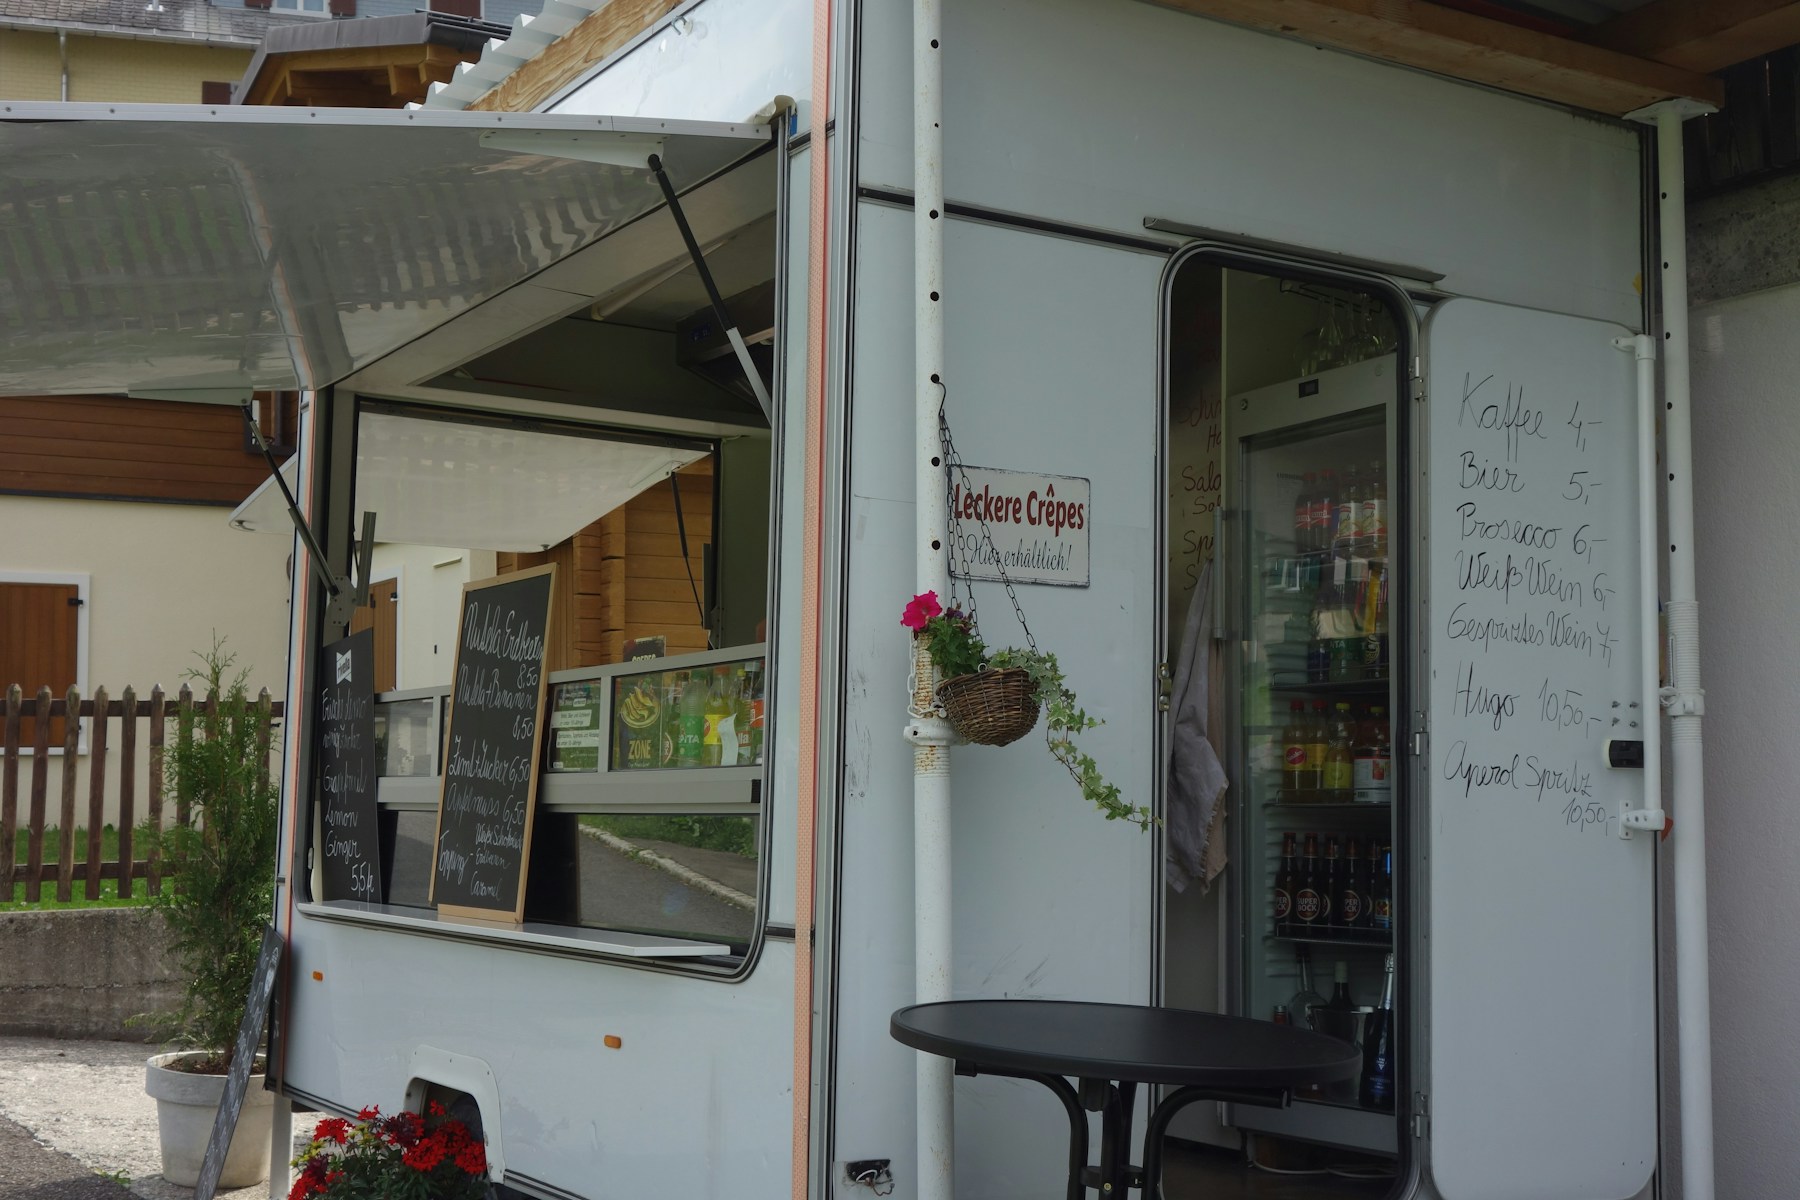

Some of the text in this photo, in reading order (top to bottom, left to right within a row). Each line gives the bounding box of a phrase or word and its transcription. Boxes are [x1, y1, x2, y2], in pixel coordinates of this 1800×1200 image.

[1458, 372, 1547, 462] Kaffee
[1459, 451, 1525, 492] Bier
[954, 483, 1084, 537] Leckere Crêpes
[1456, 502, 1563, 549] Prosecco
[1004, 538, 1072, 571] erhältlich!
[1546, 610, 1592, 657] Wein
[1453, 660, 1521, 731] Hugo
[627, 739, 652, 760] ZONE
[508, 756, 530, 790] 6,50
[1444, 740, 1593, 802] Aperol Spritz
[325, 799, 359, 828] Lemon
[502, 794, 525, 830] 6,50
[325, 830, 361, 864] Ginger
